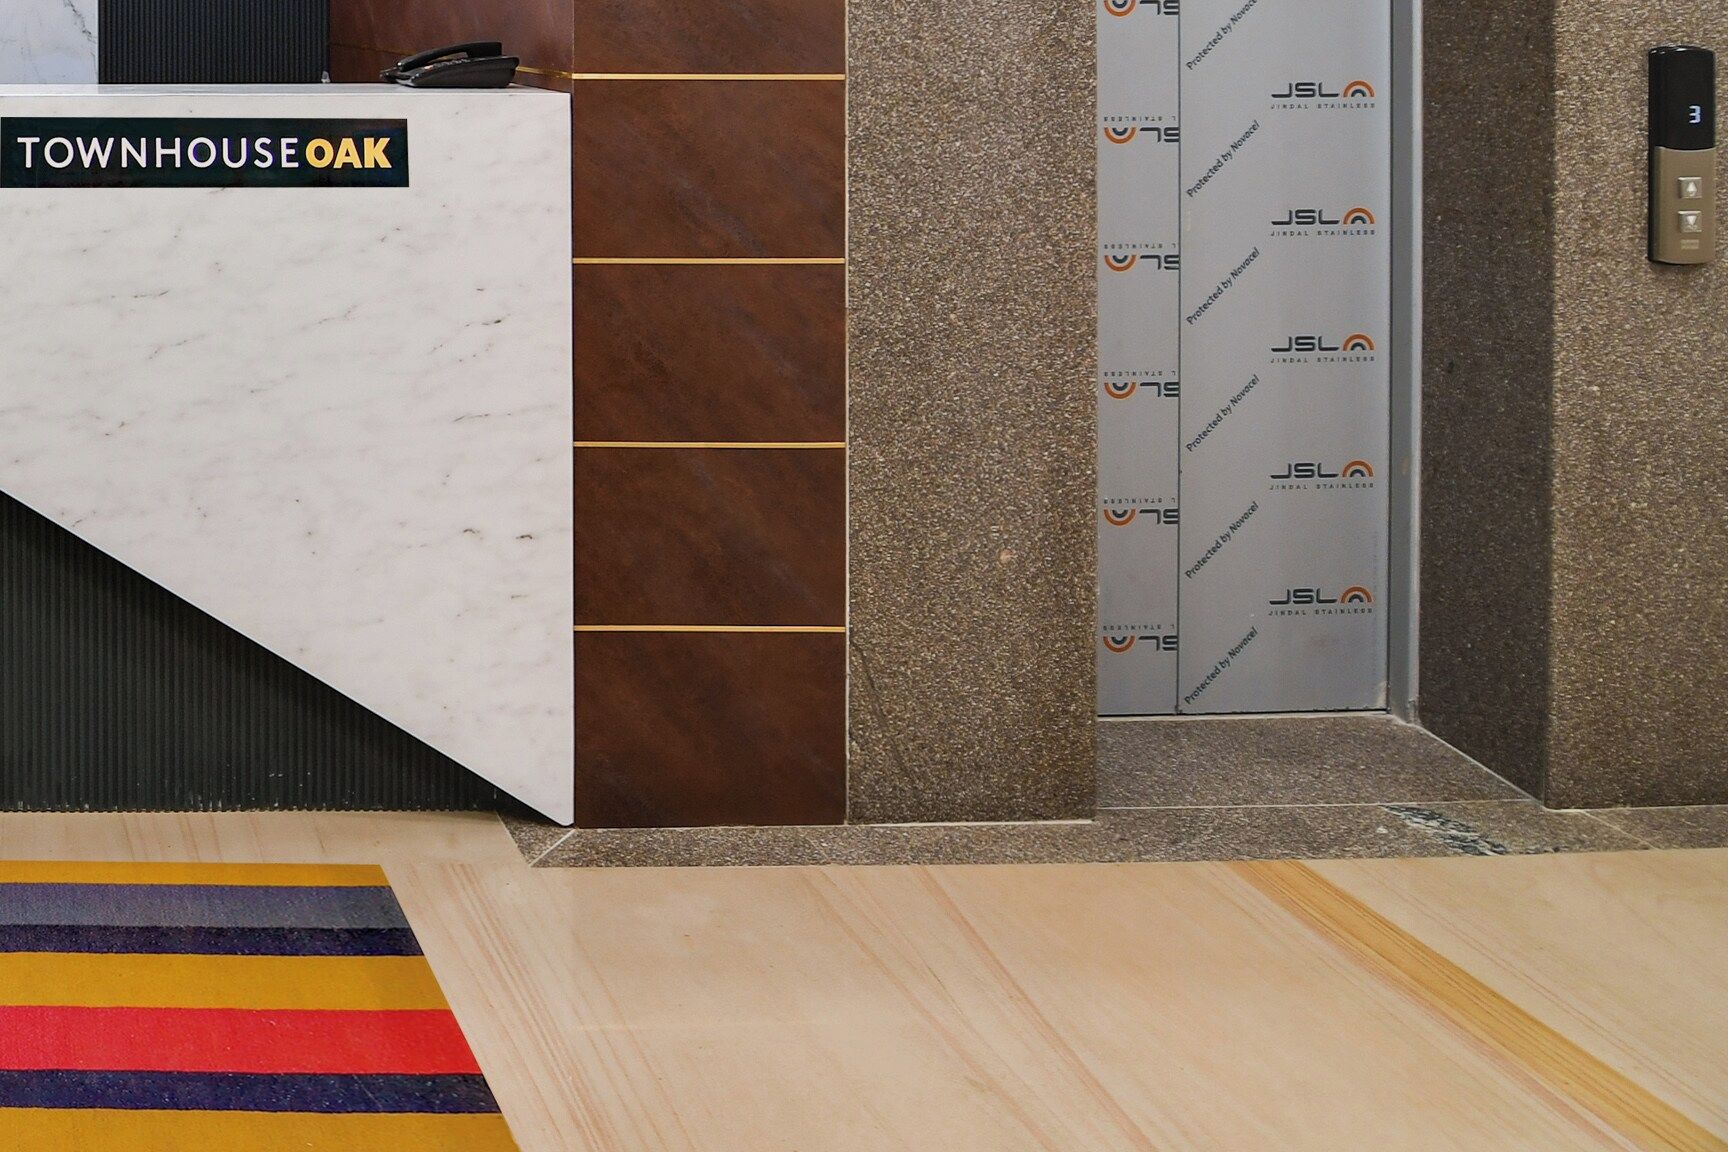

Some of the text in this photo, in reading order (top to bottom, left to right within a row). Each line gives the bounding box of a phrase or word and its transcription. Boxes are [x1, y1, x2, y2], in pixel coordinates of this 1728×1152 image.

[1186, 31, 1224, 70] Protected
[1221, 23, 1233, 34] by
[1270, 81, 1340, 98] JSL
[1689, 105, 1701, 123] 3
[1186, 120, 1260, 197] Protected by Novacel
[1270, 208, 1340, 225] JSL
[1186, 247, 1260, 325] Protected by Novacel
[1270, 335, 1340, 352] JSL
[1185, 374, 1259, 452] Protected by Novacel
[1269, 462, 1339, 479] JSL
[1184, 501, 1258, 579] Protected by Novacel
[1267, 587, 1337, 604] JSL
[1184, 626, 1258, 704] Protected by Novacel
